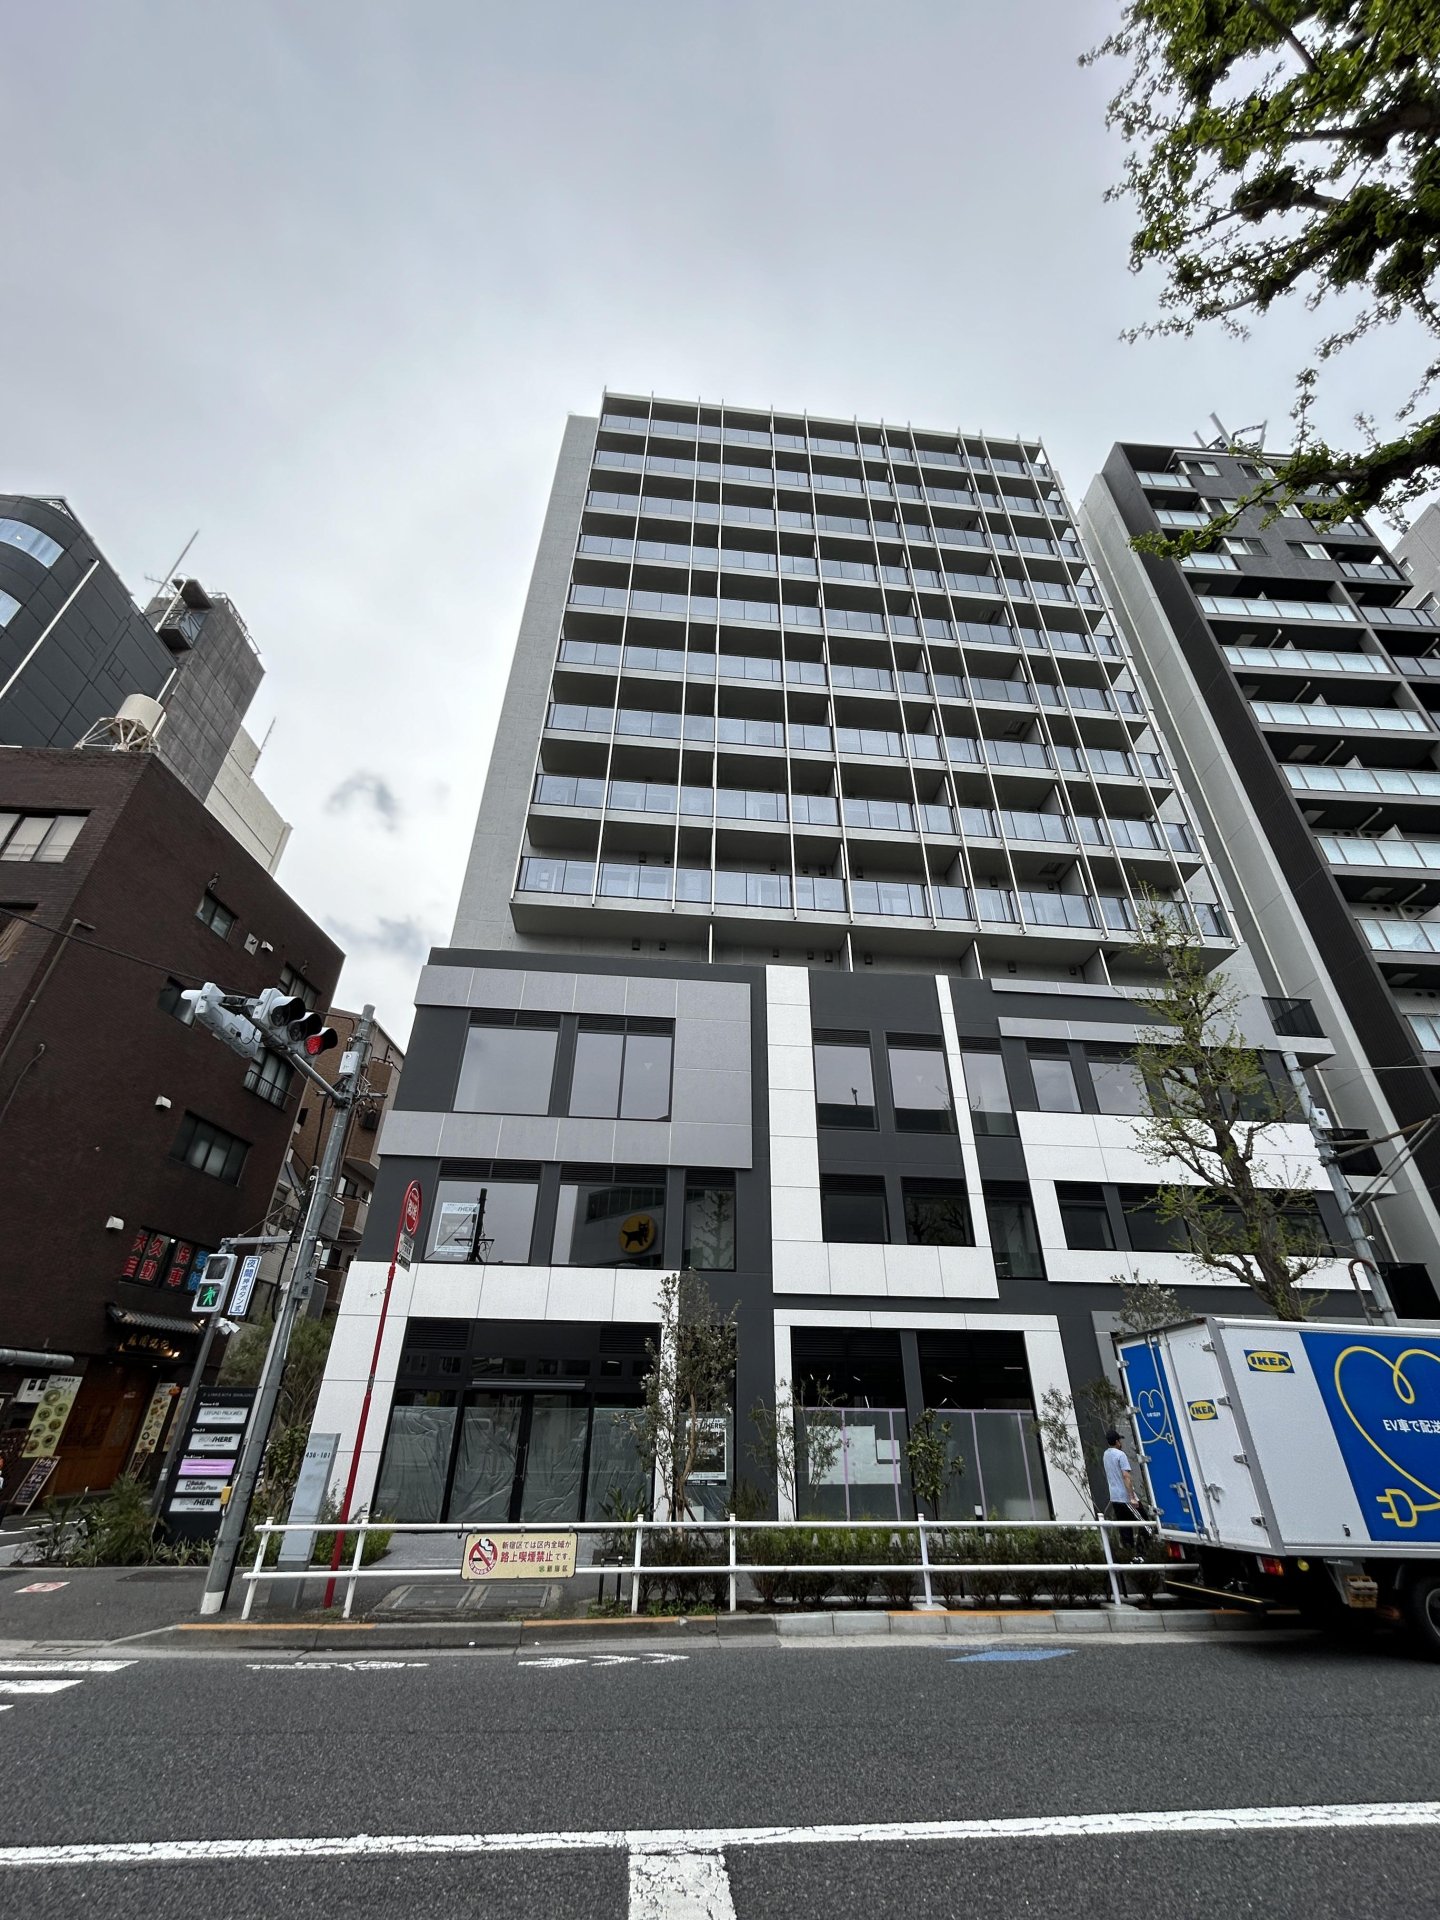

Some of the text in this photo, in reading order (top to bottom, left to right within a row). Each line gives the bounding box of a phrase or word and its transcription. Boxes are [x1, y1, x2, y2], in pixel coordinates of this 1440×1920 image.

[234, 1259, 256, 1312] 夜間押ボタン式
[1250, 1356, 1291, 1368] IKEA
[1191, 1406, 1214, 1415] IKEA
[502, 1540, 572, 1549] 新宿区では区内全域が
